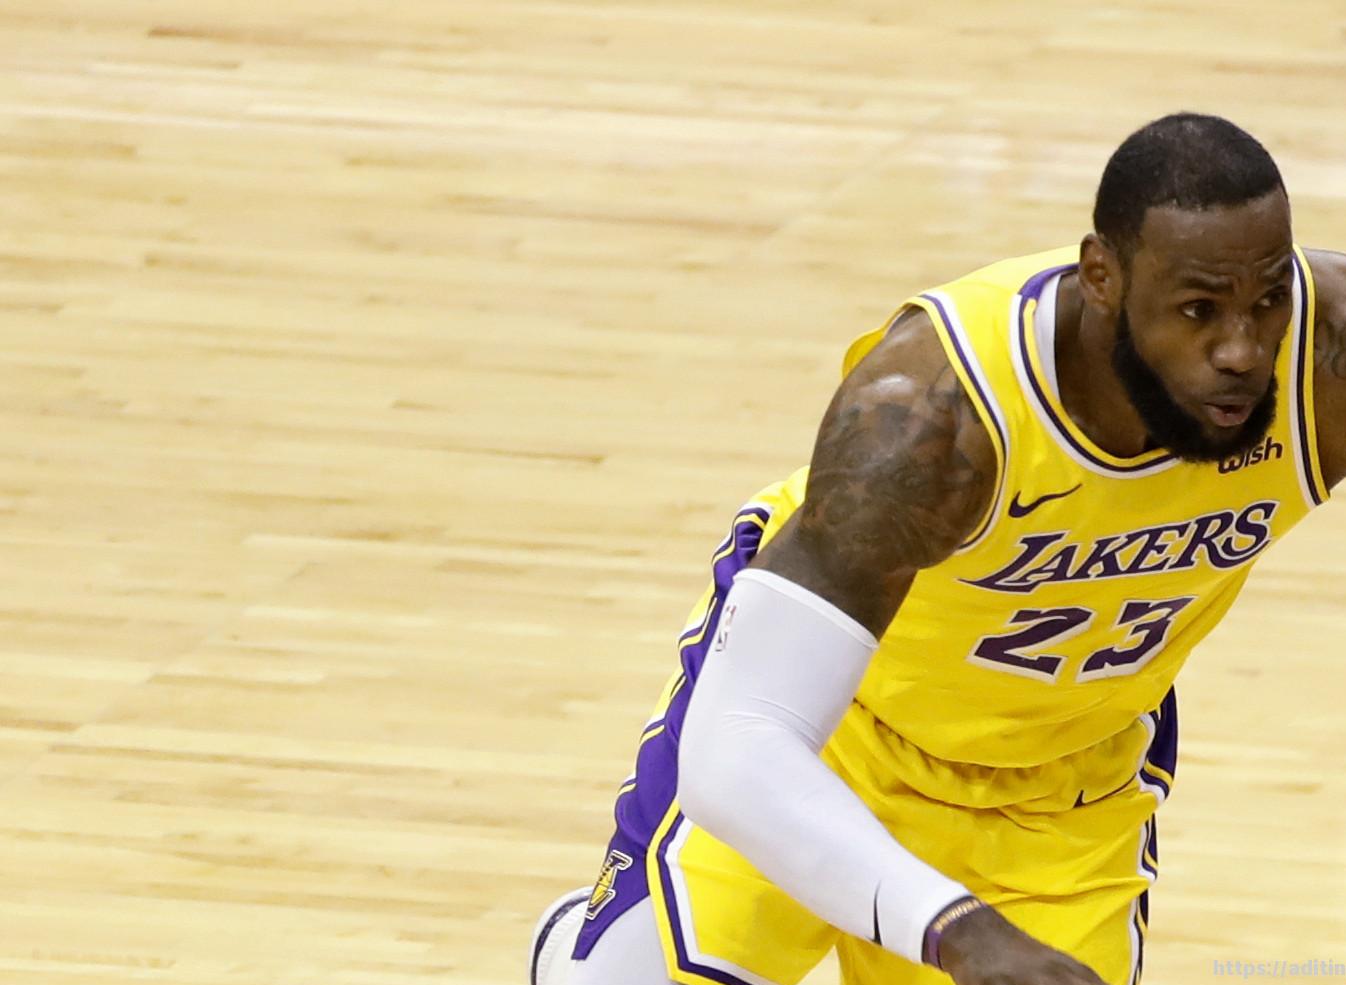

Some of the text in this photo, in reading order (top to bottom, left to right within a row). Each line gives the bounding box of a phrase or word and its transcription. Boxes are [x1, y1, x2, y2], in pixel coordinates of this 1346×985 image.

[1218, 436, 1283, 474] wish
[955, 499, 1281, 594] LAKERS
[965, 594, 1197, 684] 23
